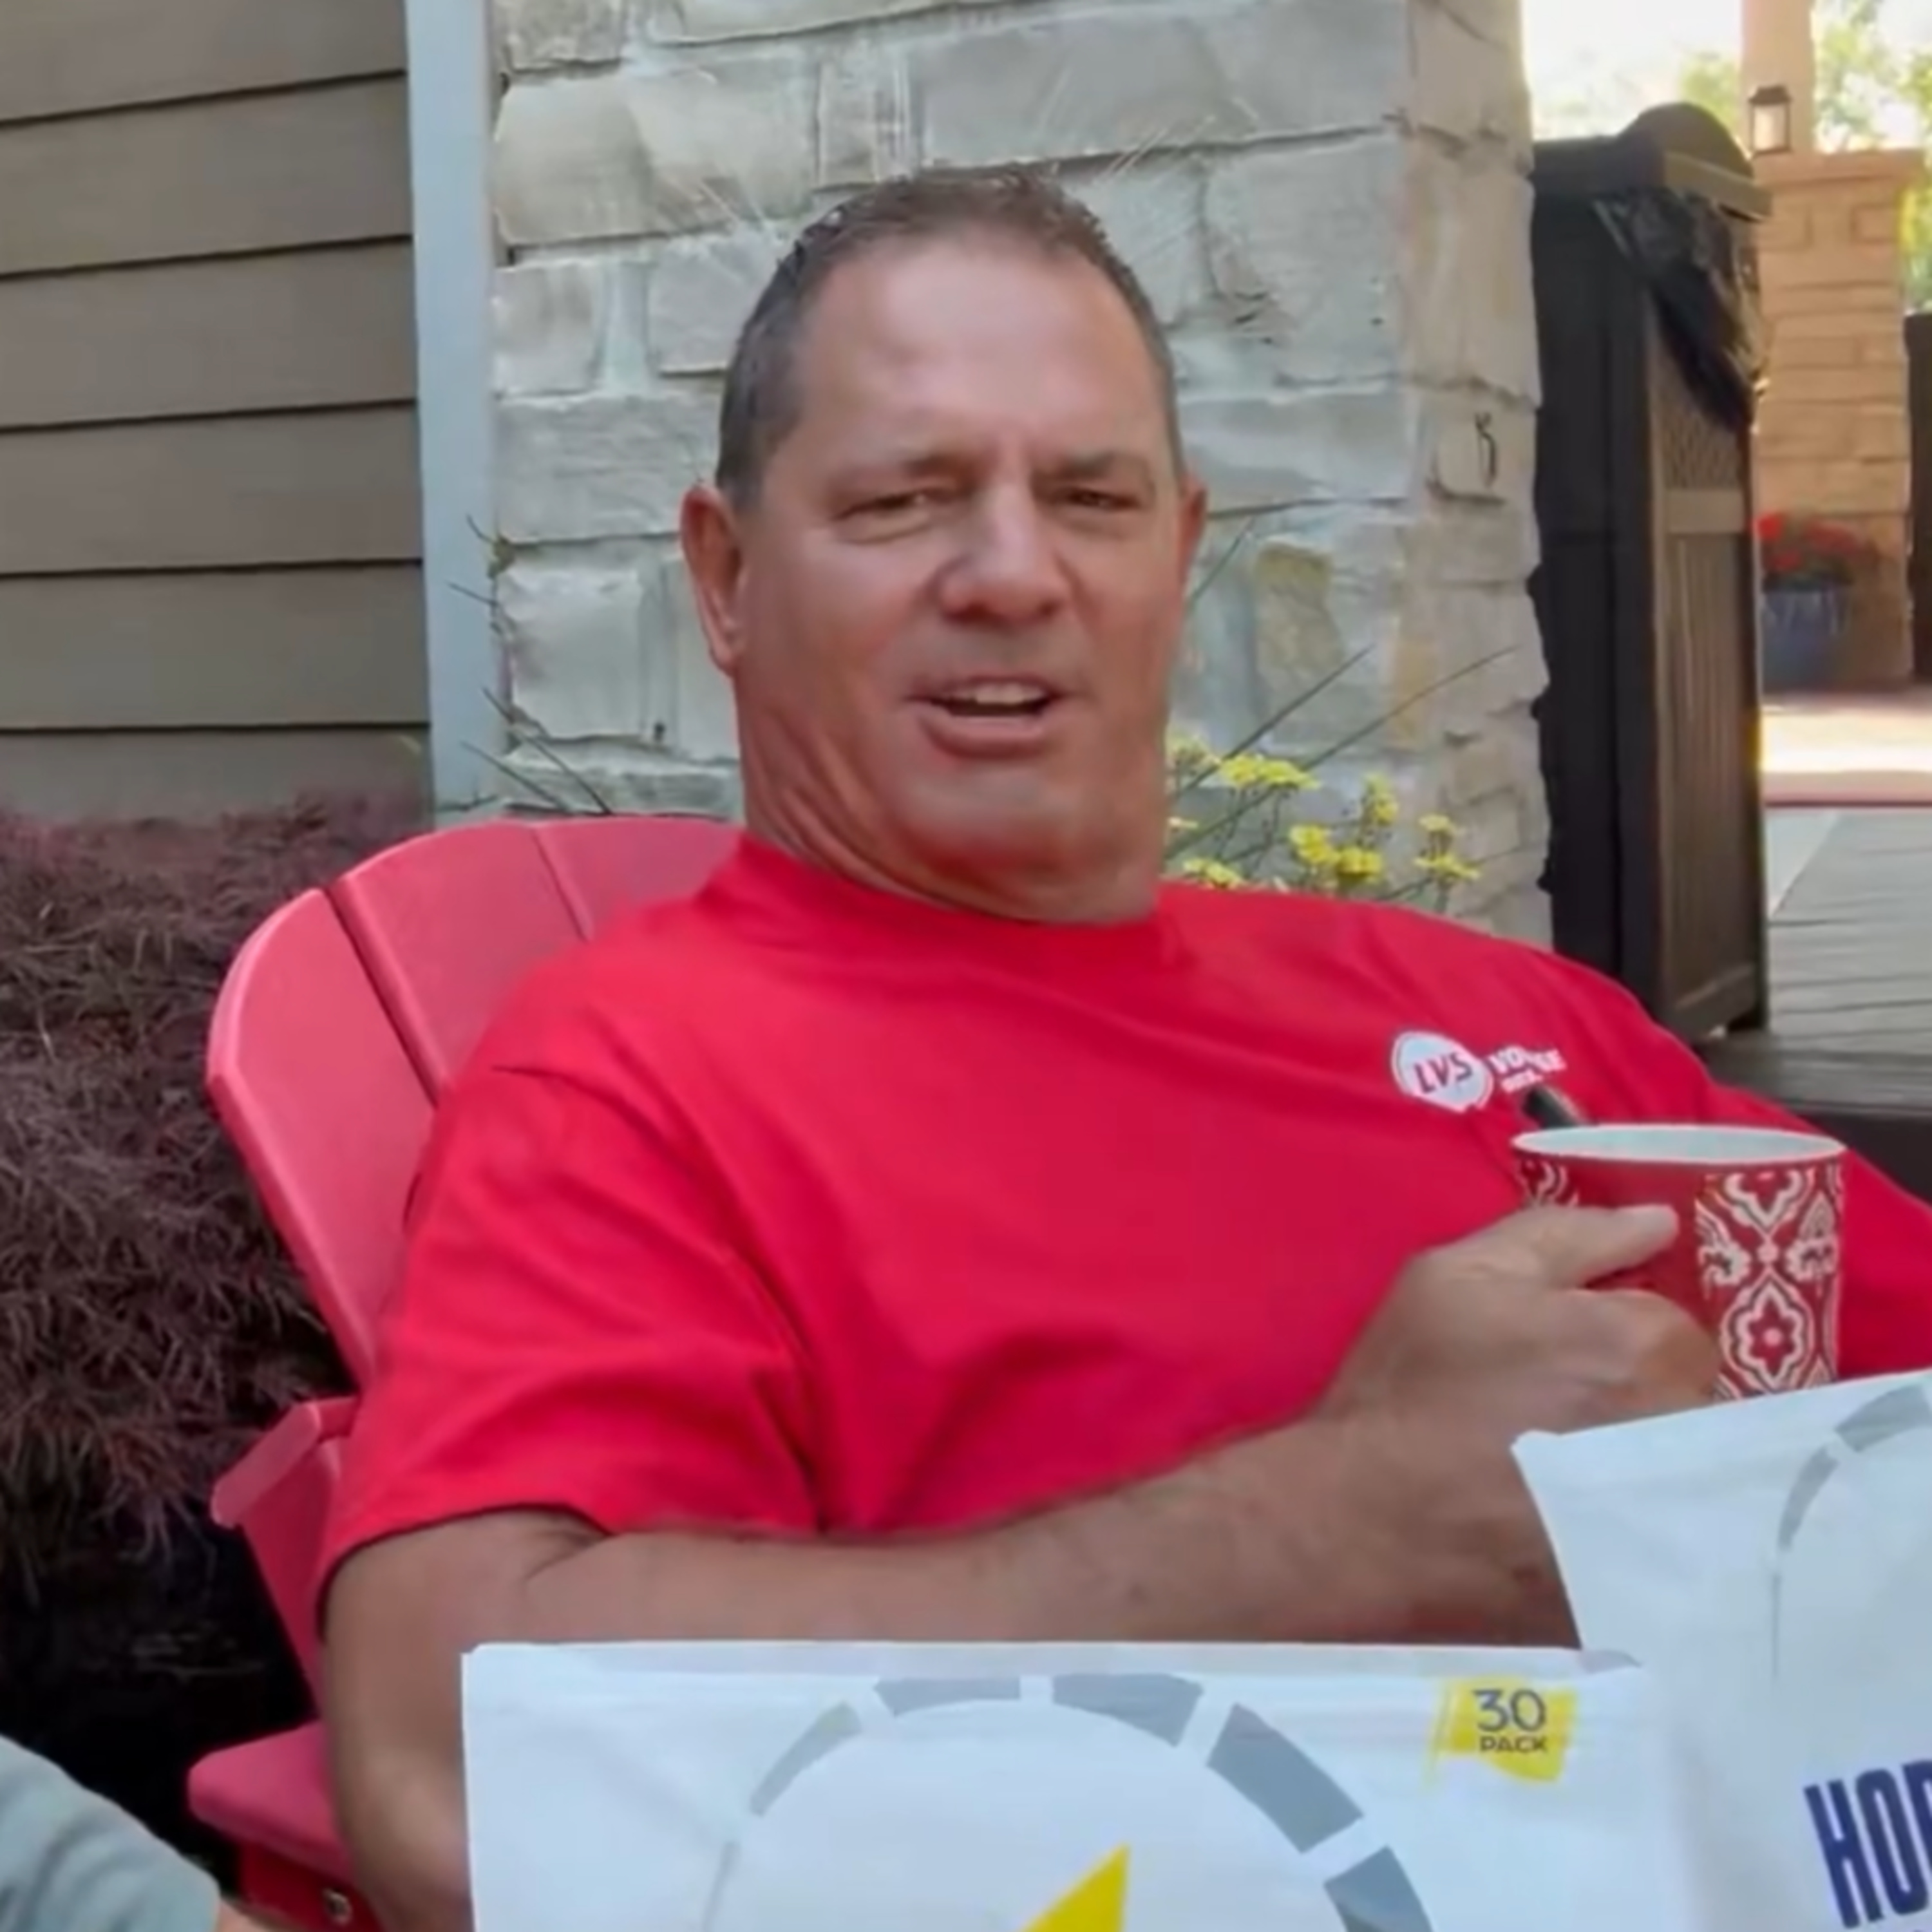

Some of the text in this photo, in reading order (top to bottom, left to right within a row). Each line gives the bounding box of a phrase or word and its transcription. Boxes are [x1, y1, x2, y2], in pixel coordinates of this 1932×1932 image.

[1414, 1052, 1473, 1094] LVS
[1472, 1689, 1547, 1732] 30
[1479, 1736, 1548, 1753] PACK
